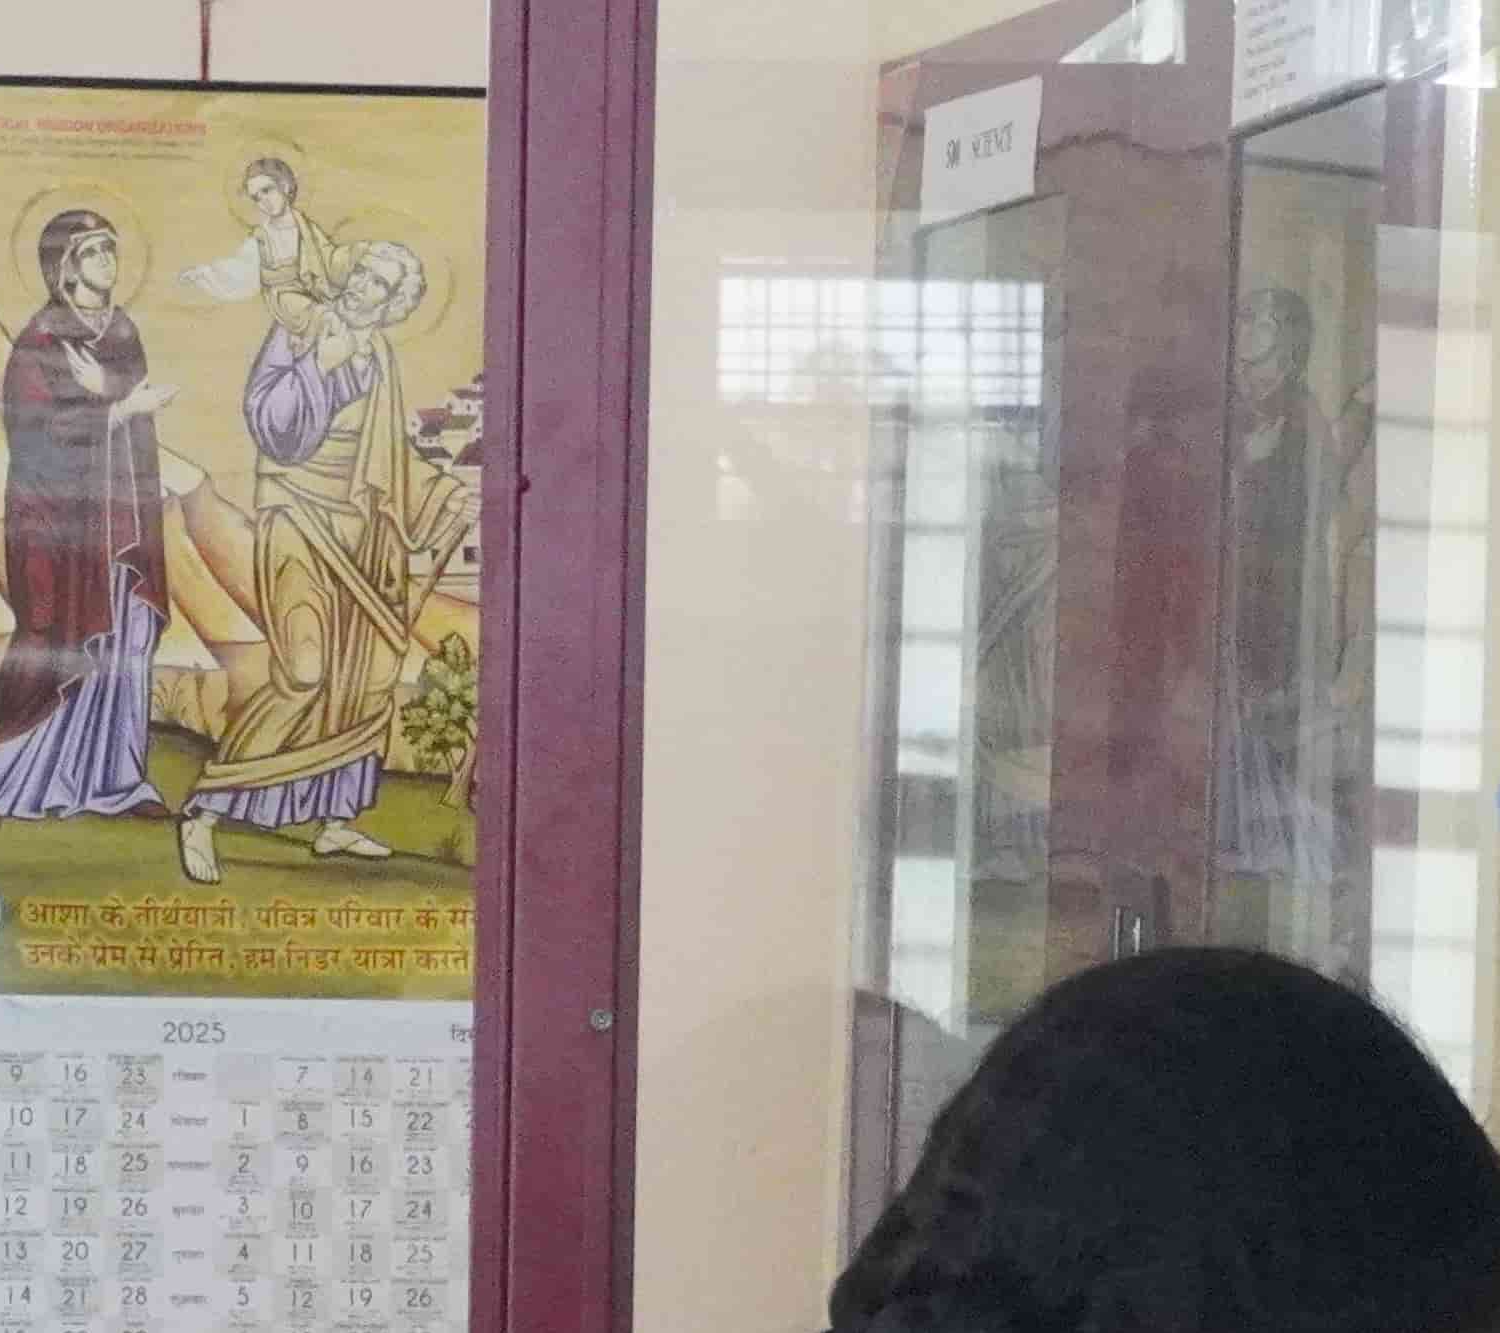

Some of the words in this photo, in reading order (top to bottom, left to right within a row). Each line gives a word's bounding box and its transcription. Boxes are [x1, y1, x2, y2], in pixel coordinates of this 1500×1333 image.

[26, 901, 88, 927] आशा
[99, 896, 127, 928] के
[256, 899, 317, 929] पवित्र
[326, 899, 405, 929] परिवार
[412, 899, 440, 929] के
[244, 948, 276, 970] हम
[284, 940, 342, 970] निडर
[351, 948, 405, 971] यात्रा
[162, 1021, 227, 1044] 2025
[9, 1064, 23, 1082] 9
[63, 1064, 88, 1083] 16
[297, 1066, 309, 1084] 7
[408, 1067, 434, 1087] 21
[8, 1107, 35, 1126] 10
[63, 1108, 88, 1127] 17
[121, 1111, 146, 1129] 24
[296, 1112, 309, 1131] 8
[350, 1109, 373, 1128] 15
[406, 1112, 434, 1131] 22
[9, 1152, 32, 1170] 11
[63, 1155, 87, 1175] 18
[121, 1153, 148, 1172] 25
[237, 1154, 250, 1174] 2
[295, 1154, 309, 1174] 9
[350, 1154, 373, 1174] 16
[406, 1155, 433, 1175] 23
[4, 1197, 28, 1216] 12
[62, 1197, 88, 1216] 19
[121, 1197, 148, 1216] 26
[237, 1196, 249, 1215] 3
[291, 1200, 313, 1220] 10
[350, 1199, 373, 1219] 17
[406, 1201, 432, 1220] 24
[4, 1241, 28, 1261] 13
[61, 1241, 89, 1261] 20
[121, 1241, 148, 1261] 27
[236, 1243, 249, 1261] 4
[292, 1243, 313, 1262] 11
[350, 1243, 373, 1264] 18
[406, 1244, 433, 1264] 25
[8, 1285, 32, 1304] 14
[62, 1289, 86, 1306] 21
[121, 1286, 148, 1306] 28
[237, 1286, 249, 1306] 5
[291, 1290, 313, 1309] 12
[350, 1288, 373, 1307] 19
[405, 1288, 433, 1308] 26
